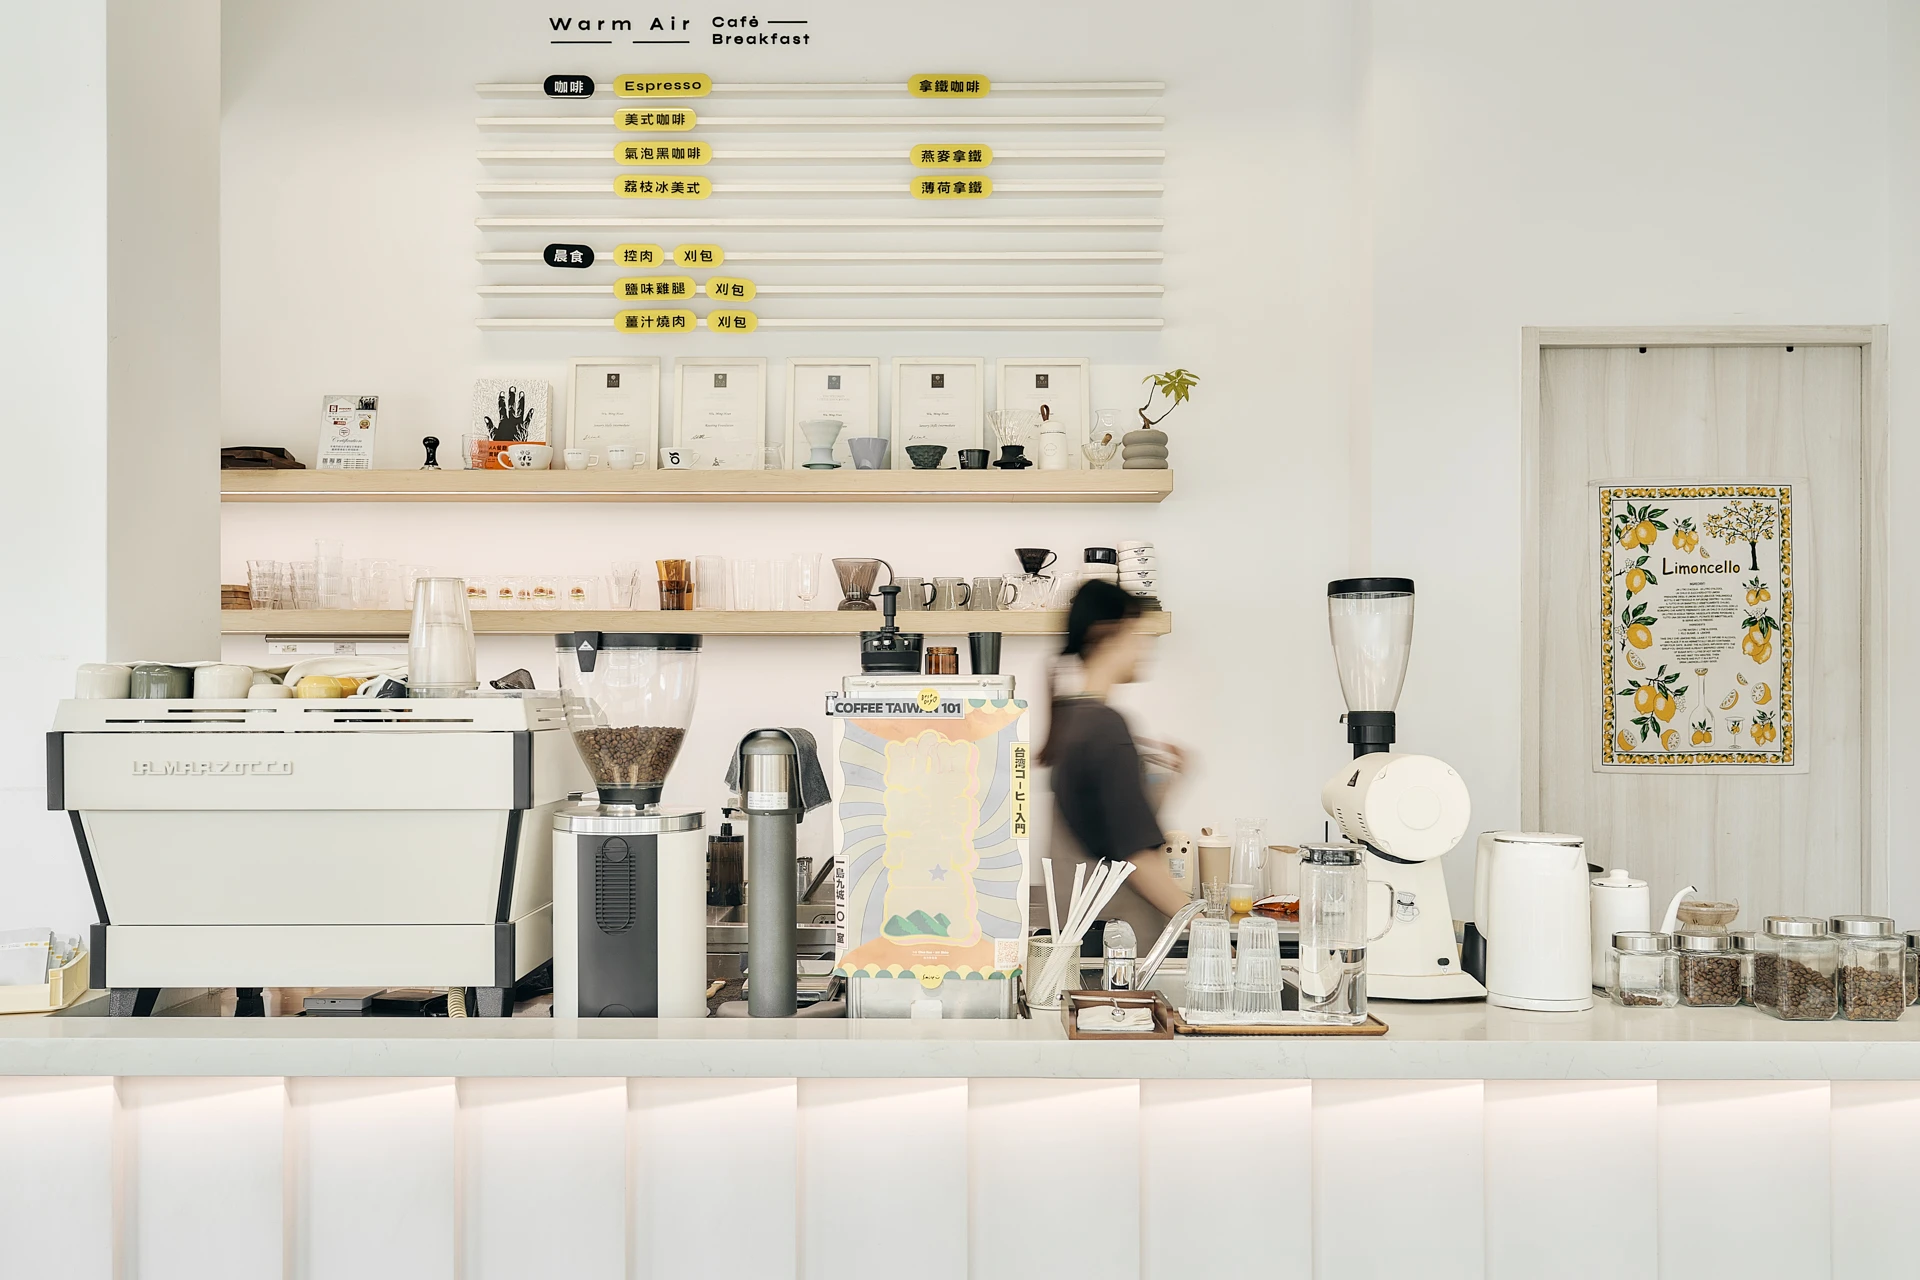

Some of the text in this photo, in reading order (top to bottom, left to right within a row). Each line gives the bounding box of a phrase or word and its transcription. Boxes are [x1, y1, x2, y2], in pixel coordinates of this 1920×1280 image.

[549, 16, 690, 31] Warm Air
[712, 32, 810, 45] Breakfast
[554, 80, 584, 94] 咖啡
[625, 80, 702, 94] Espresso
[919, 79, 980, 93] 拿鐵咖啡
[625, 112, 686, 126] 美式咖啡
[625, 146, 701, 160] 氣泡黑咖啡
[921, 149, 982, 163] 燕麥拿鐵
[624, 179, 700, 195] 荔枝冰美式
[921, 180, 983, 194] 薄荷拿鐵
[553, 249, 584, 264] 晨食
[624, 249, 713, 263] 控肉 刈包
[625, 282, 744, 297] 鹽味雞腿 刈包
[625, 314, 747, 329] 薑汁燒肉 刈包
[1662, 557, 1741, 576] Limoncello
[835, 702, 961, 714] COFFEE TAIW 101
[1014, 746, 1027, 835] 台湾コーヒー入門
